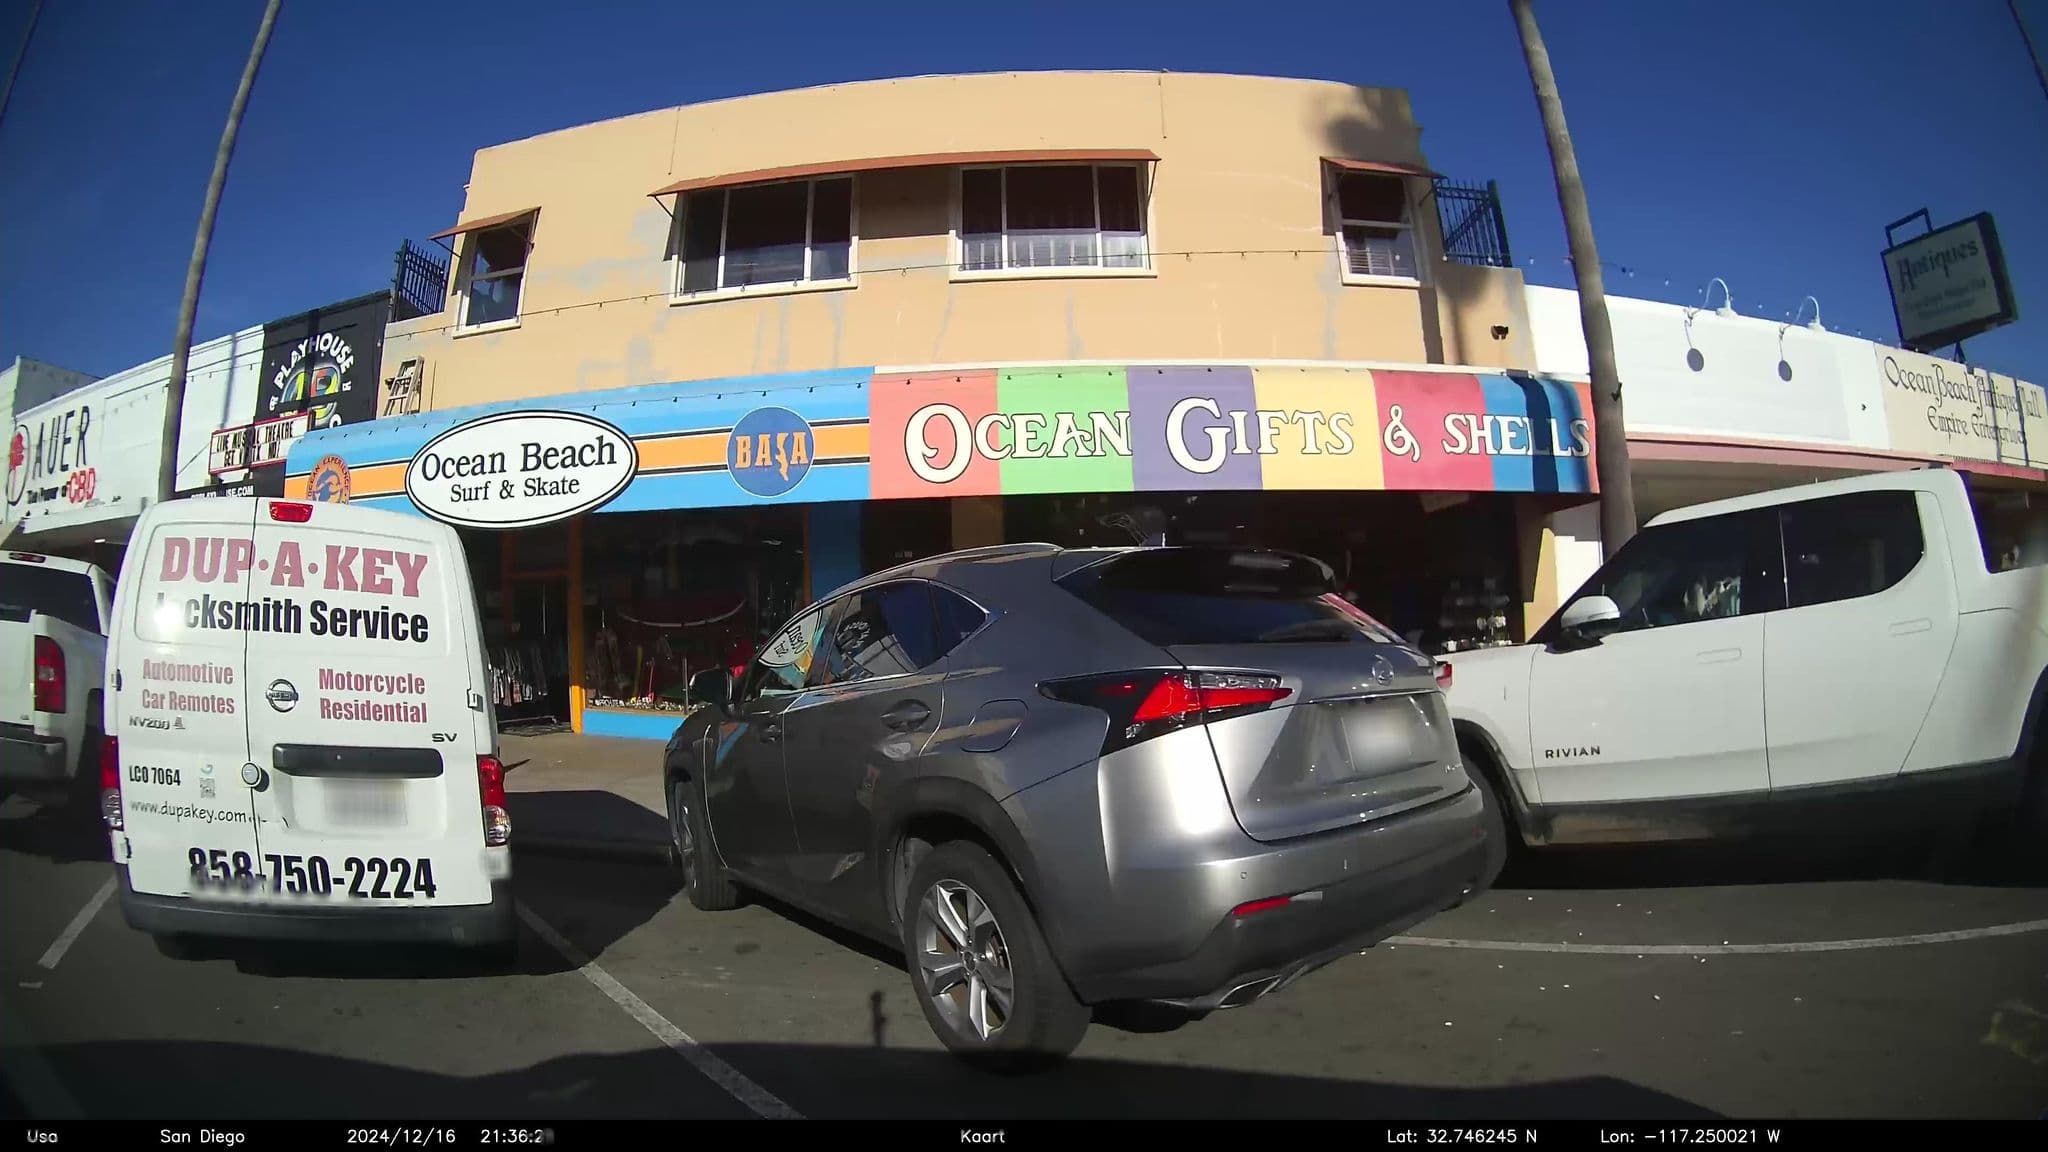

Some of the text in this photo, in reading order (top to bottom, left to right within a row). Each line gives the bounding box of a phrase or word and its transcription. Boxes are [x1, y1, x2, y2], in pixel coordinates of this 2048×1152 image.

[274, 332, 354, 389] PLAYHOUSE
[1884, 356, 1936, 395] Ocean
[1932, 363, 1977, 408] Beach
[1927, 405, 1968, 445] Empire
[904, 397, 1591, 484] OCEAN GIFTS & SHELLS
[421, 435, 617, 481] Ocean Beach
[450, 475, 580, 502] Surf & Skate
[157, 592, 429, 643] cksmith Service
[143, 659, 234, 685] Automotive
[319, 668, 426, 695] Motorcycle
[142, 689, 235, 714] Car Remotes
[320, 698, 427, 723] Residential
[129, 715, 170, 730] NV200
[432, 733, 457, 742] SV
[1545, 746, 1600, 759] RIVIAN
[152, 767, 181, 786] 7064
[131, 801, 246, 823] www.dupakey.com
[188, 847, 437, 898] 858-750-2224
